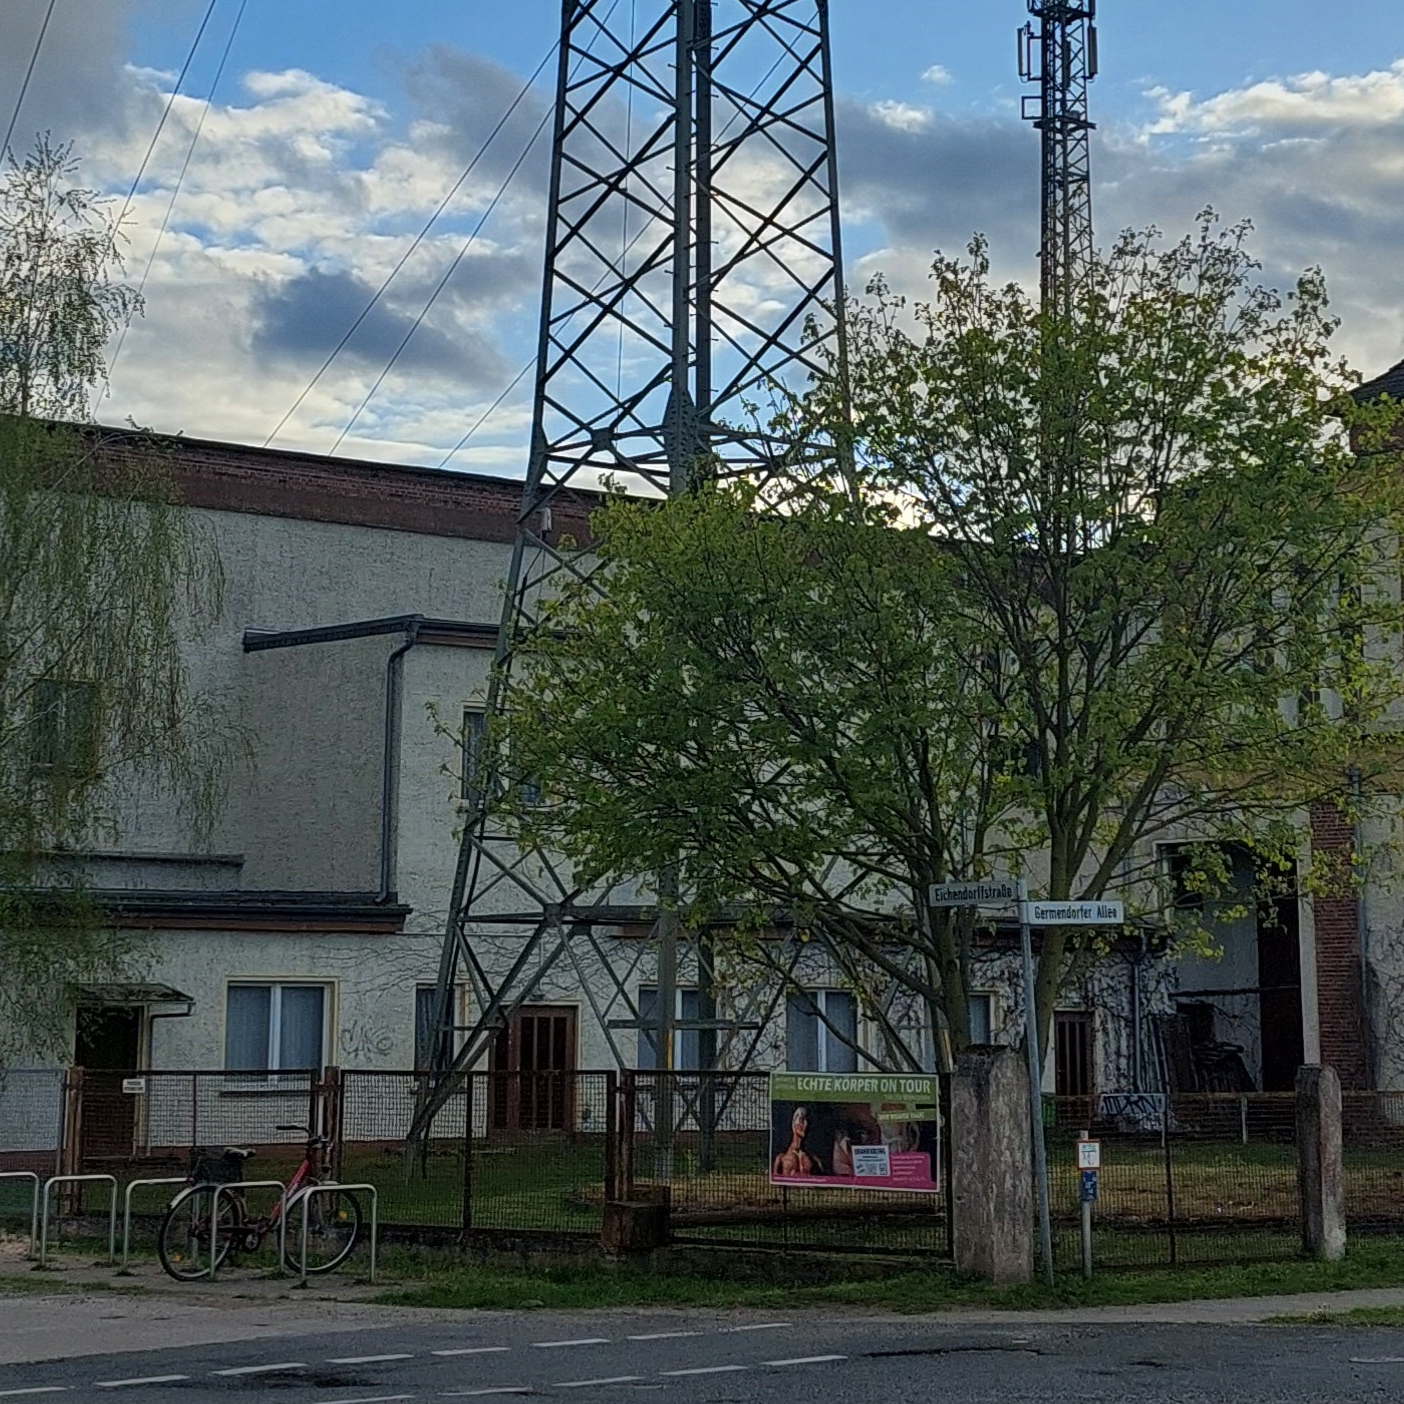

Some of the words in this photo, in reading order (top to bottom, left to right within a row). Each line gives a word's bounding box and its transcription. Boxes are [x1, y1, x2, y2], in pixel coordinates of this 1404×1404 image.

[934, 885, 1013, 902] Eichendorffstraße
[1034, 905, 1092, 920] Germendorfer
[1096, 905, 1117, 919] Allee
[797, 1077, 832, 1092] ECHTE
[833, 1075, 878, 1093] KÖRPER
[880, 1078, 897, 1093] ON
[899, 1078, 931, 1094] TOUR
